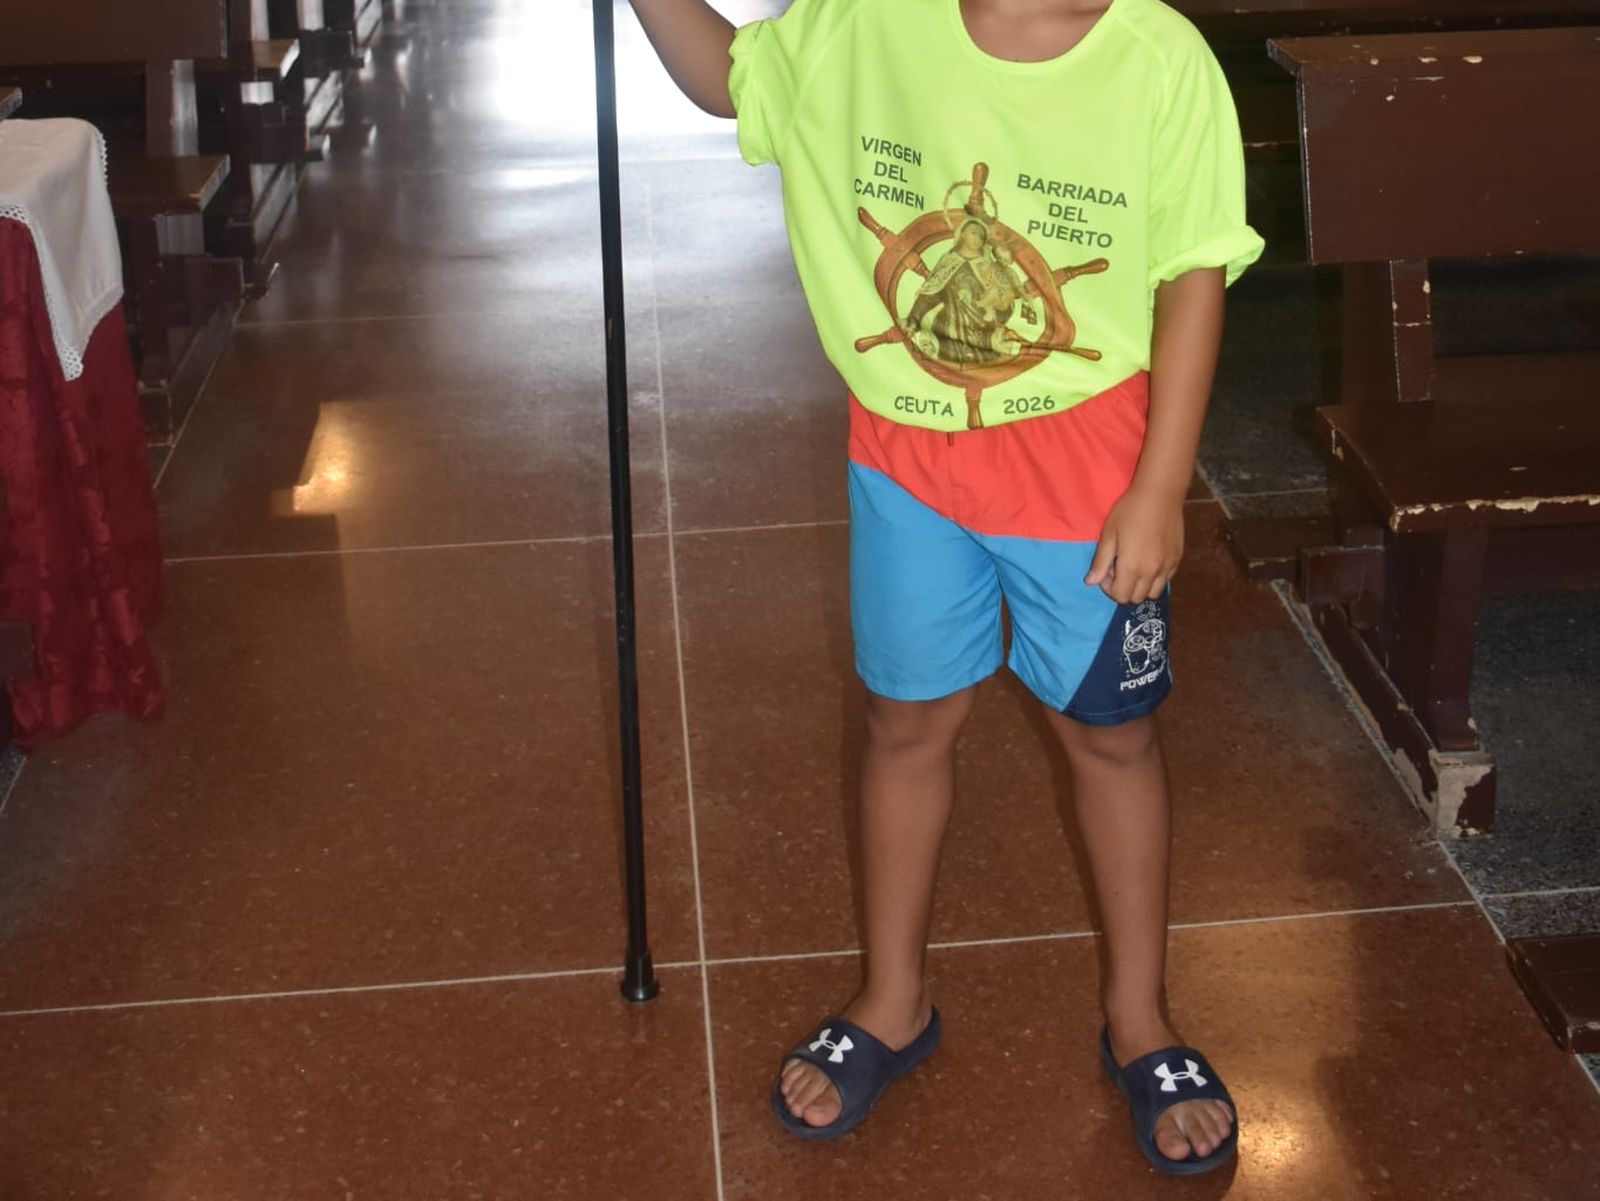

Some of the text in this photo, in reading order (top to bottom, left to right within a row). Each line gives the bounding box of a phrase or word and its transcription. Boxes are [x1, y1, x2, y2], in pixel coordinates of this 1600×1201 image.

[861, 136, 922, 167] VIRGEN
[874, 161, 908, 184] DEL
[854, 178, 924, 211] CARMEN
[1017, 173, 1127, 208] BARRIADA
[1048, 202, 1088, 224] DEL
[1027, 219, 1113, 248] PUERTO
[894, 395, 1055, 417] CEUTA 2026
